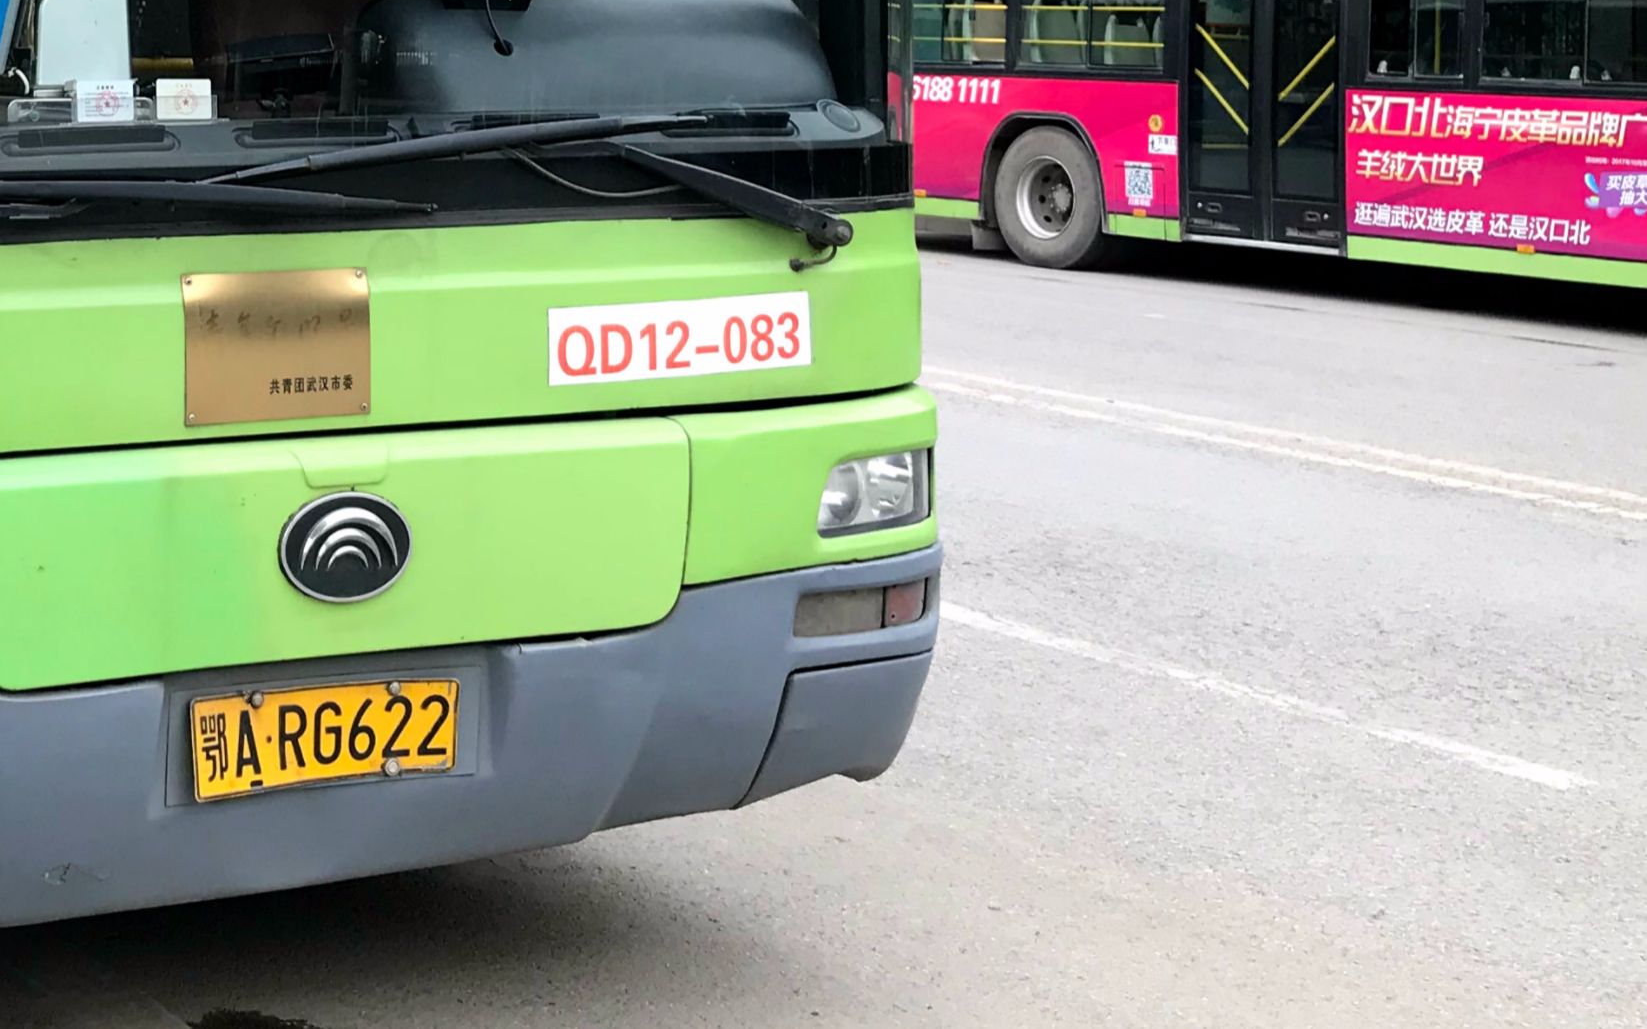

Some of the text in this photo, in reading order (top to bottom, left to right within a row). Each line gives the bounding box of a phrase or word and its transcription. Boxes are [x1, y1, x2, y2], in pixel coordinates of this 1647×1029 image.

[958, 77, 1001, 104] 1111
[1355, 149, 1484, 187] 羊绒大世界
[1354, 202, 1592, 246] 逛遍武汉选皮革 还是汉口北
[557, 312, 801, 377] QD12-083
[269, 374, 353, 395] 共青团武汉市委
